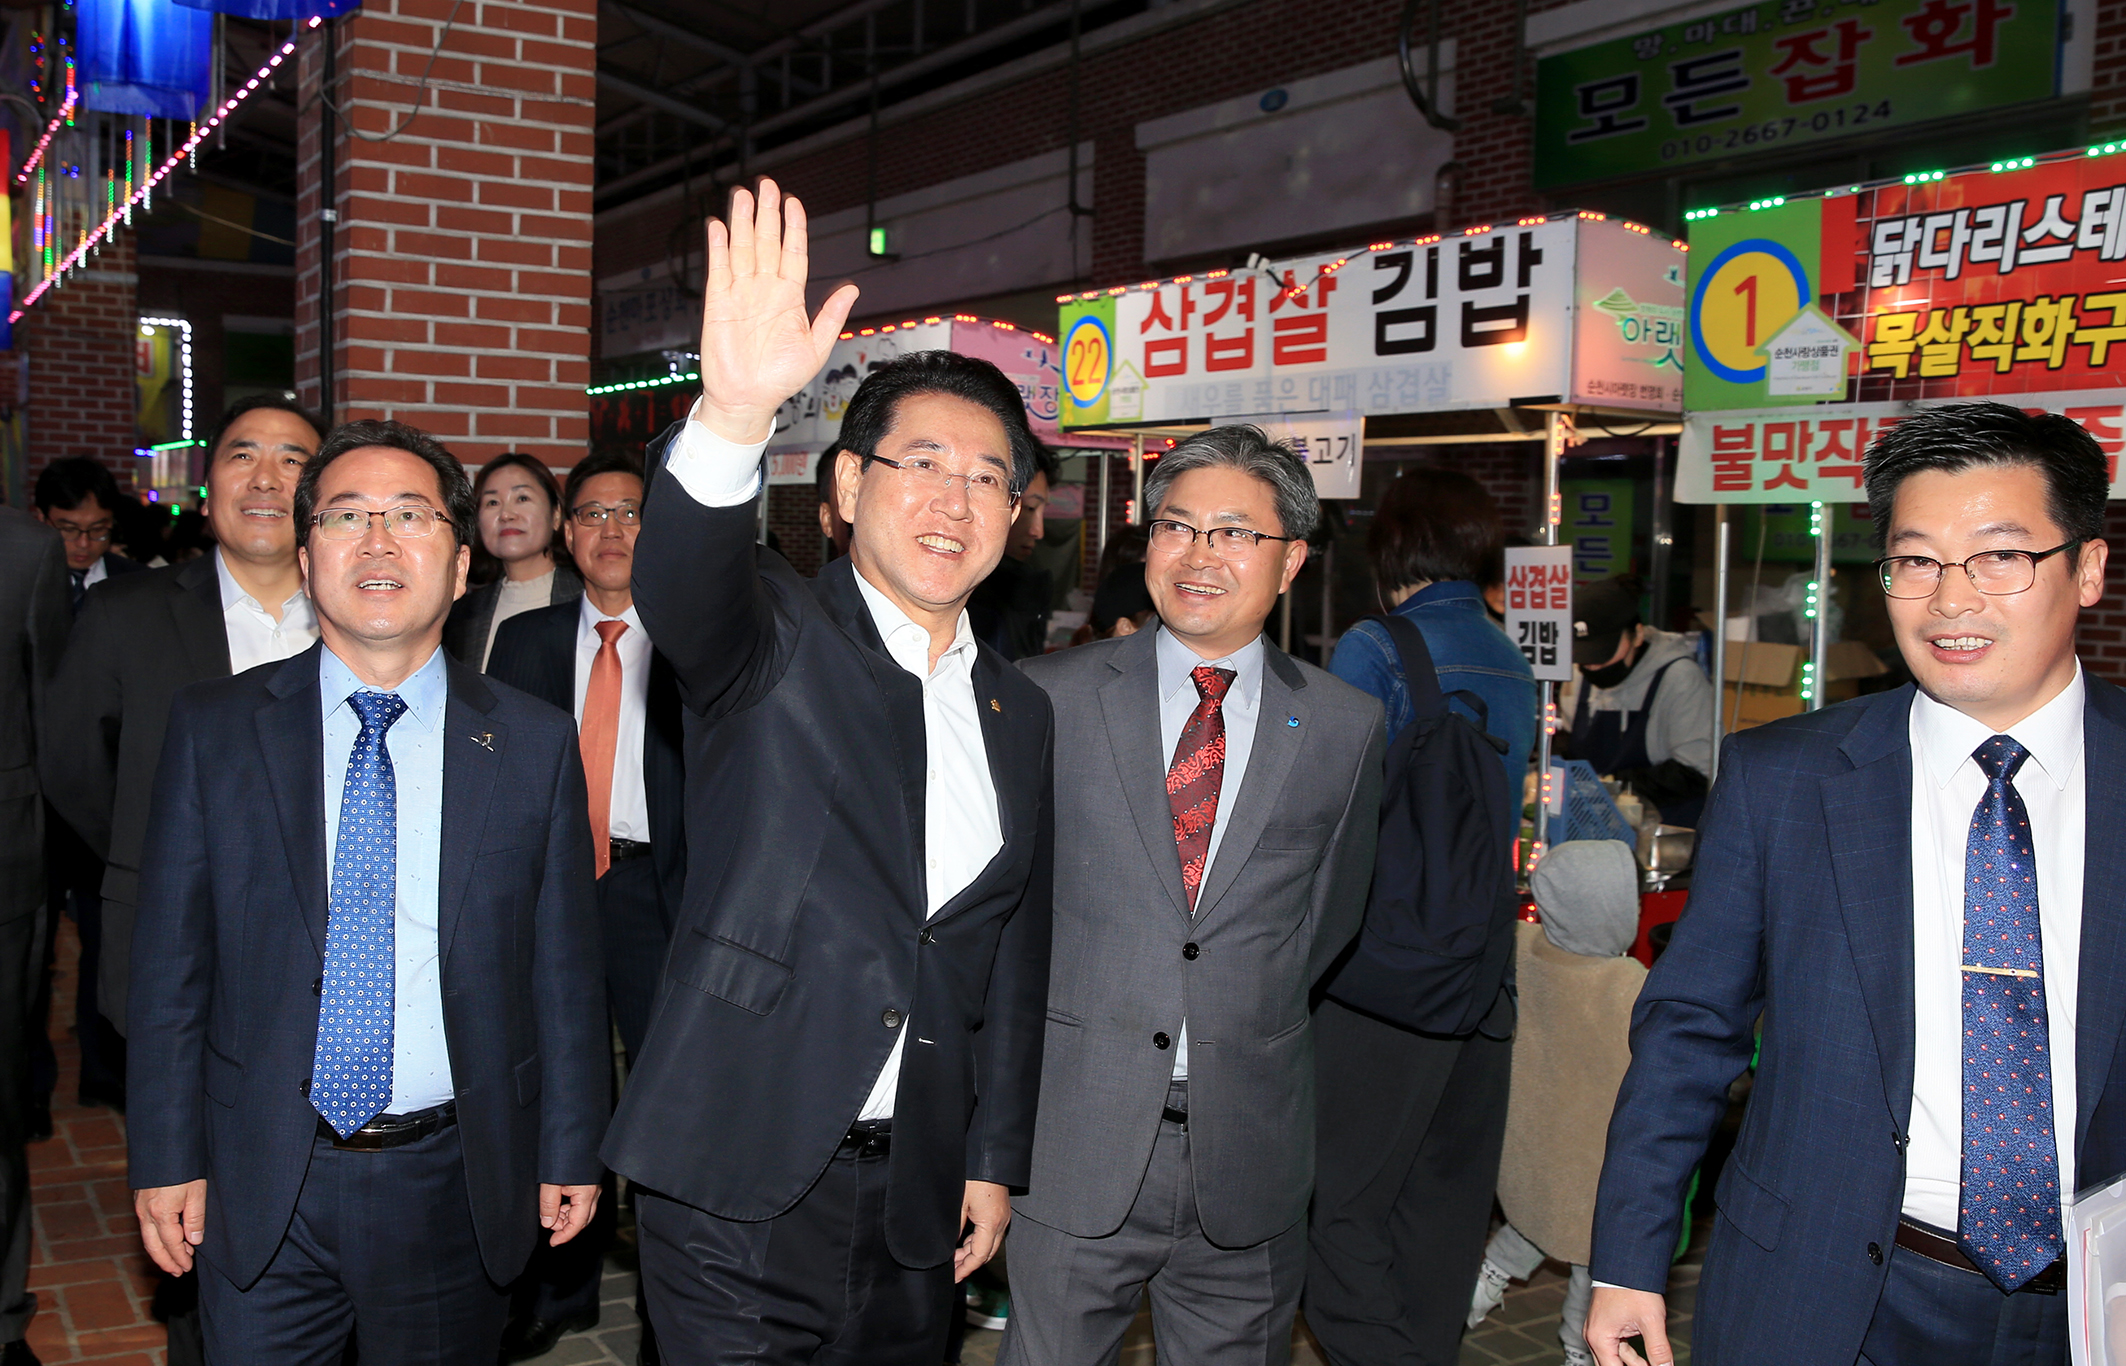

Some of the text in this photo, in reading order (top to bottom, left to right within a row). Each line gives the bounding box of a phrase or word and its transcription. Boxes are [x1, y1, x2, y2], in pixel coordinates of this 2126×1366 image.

[1661, 99, 1892, 160] 010-2667-0124
[1140, 230, 1543, 378] 삼겹살 김밥
[1733, 275, 1757, 347] 1
[1071, 338, 1102, 386] 22
[1368, 365, 1452, 408] 삼겹살
[1508, 564, 1570, 610] 삼겹살
[1518, 620, 1559, 667] 김밥
